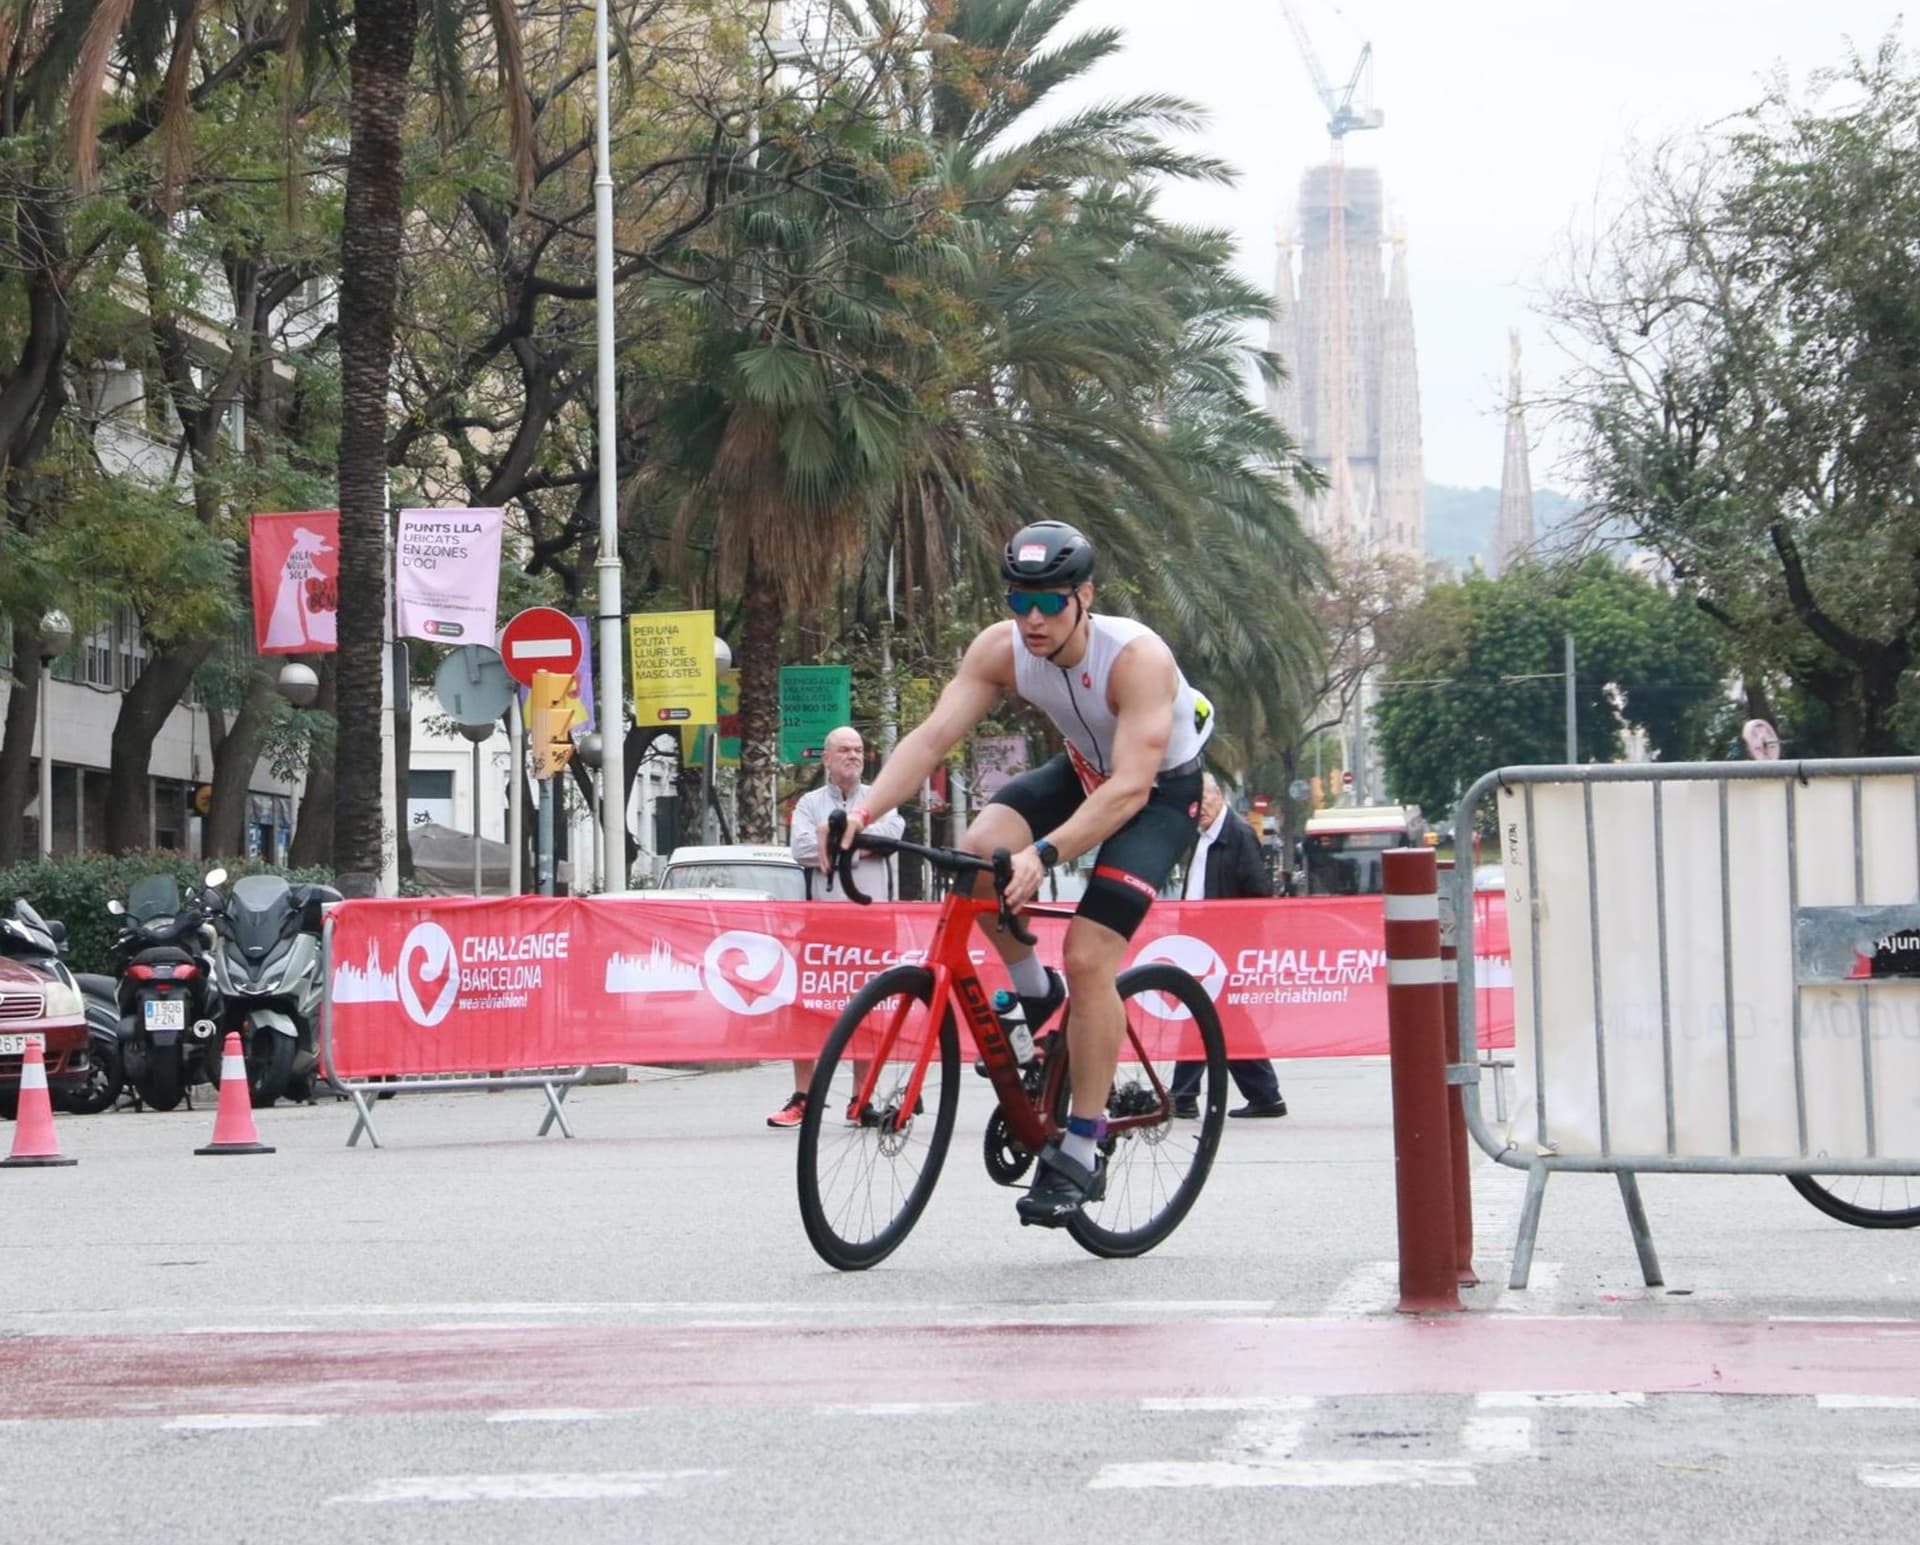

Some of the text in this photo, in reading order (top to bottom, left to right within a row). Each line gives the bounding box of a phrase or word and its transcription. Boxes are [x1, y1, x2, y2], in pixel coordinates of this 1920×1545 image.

[405, 523, 482, 533] PUNTS LILA
[404, 534, 460, 545] UBICATS
[403, 544, 468, 559] EN ZONES
[402, 556, 437, 570] D'OCI
[633, 625, 679, 636] PER UNA
[634, 637, 672, 647] CIUTAT
[635, 646, 688, 658] LLIURE DE
[636, 669, 702, 680] MASCLISTES
[462, 931, 569, 962] CHALLENGE
[1878, 936, 1920, 954] Ajun
[461, 965, 542, 991] BARCELONA
[1227, 987, 1349, 1004] wearetriathlon!
